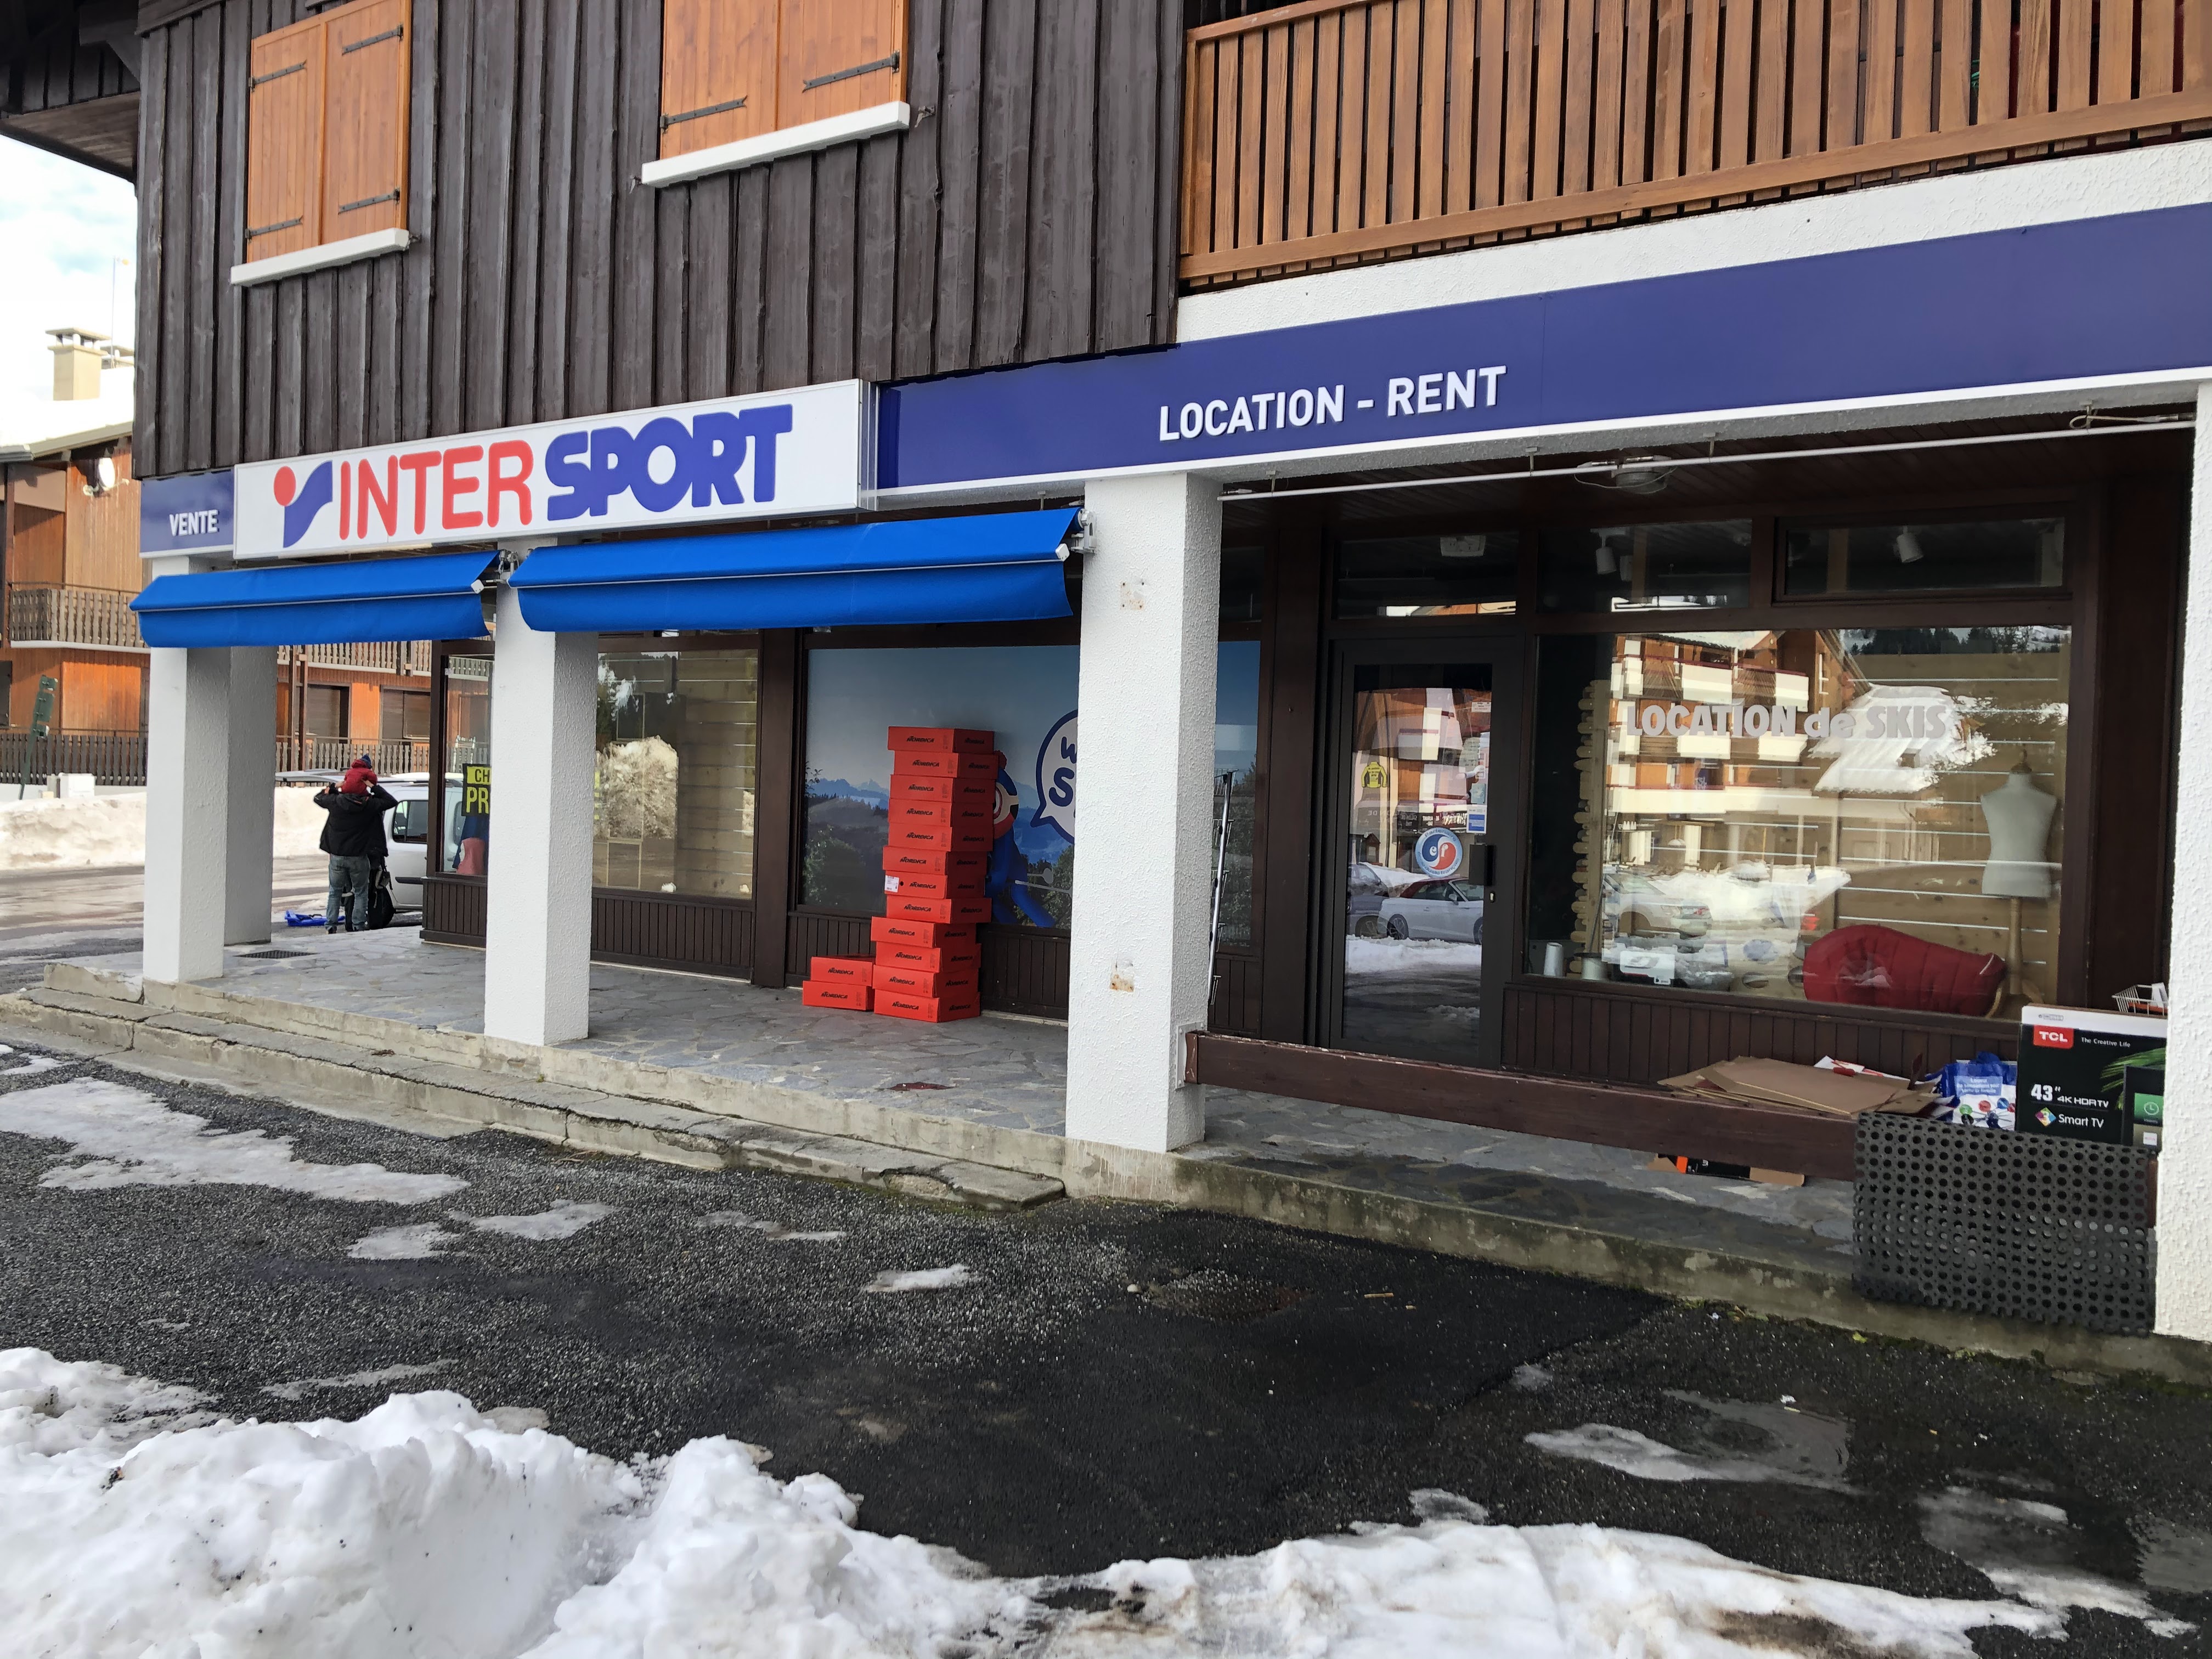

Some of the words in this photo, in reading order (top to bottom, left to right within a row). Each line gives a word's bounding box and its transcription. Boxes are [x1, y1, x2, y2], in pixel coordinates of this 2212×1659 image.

[1159, 384, 1345, 442] LOCATION
[1387, 365, 1508, 417] RENT
[338, 403, 793, 541] INTERSPORT
[169, 509, 219, 537] VENTE
[1627, 704, 1797, 738] LOCATION
[1804, 707, 1857, 740] de
[1866, 705, 1948, 740] SKIS
[906, 808, 933, 816] NORDICA
[906, 832, 934, 840] NORDICA
[900, 856, 926, 865] NORDICA
[910, 881, 936, 889] NORDICA
[888, 928, 915, 936] NORDICA
[895, 952, 922, 961] NORDICA
[889, 976, 915, 985] NORDICA
[892, 1001, 919, 1010] NORDICA
[2039, 1030, 2068, 1043] TCL
[2093, 1039, 2118, 1047] Creative
[2058, 1114, 2089, 1127] Smart
[2091, 1117, 2104, 1128] TV
